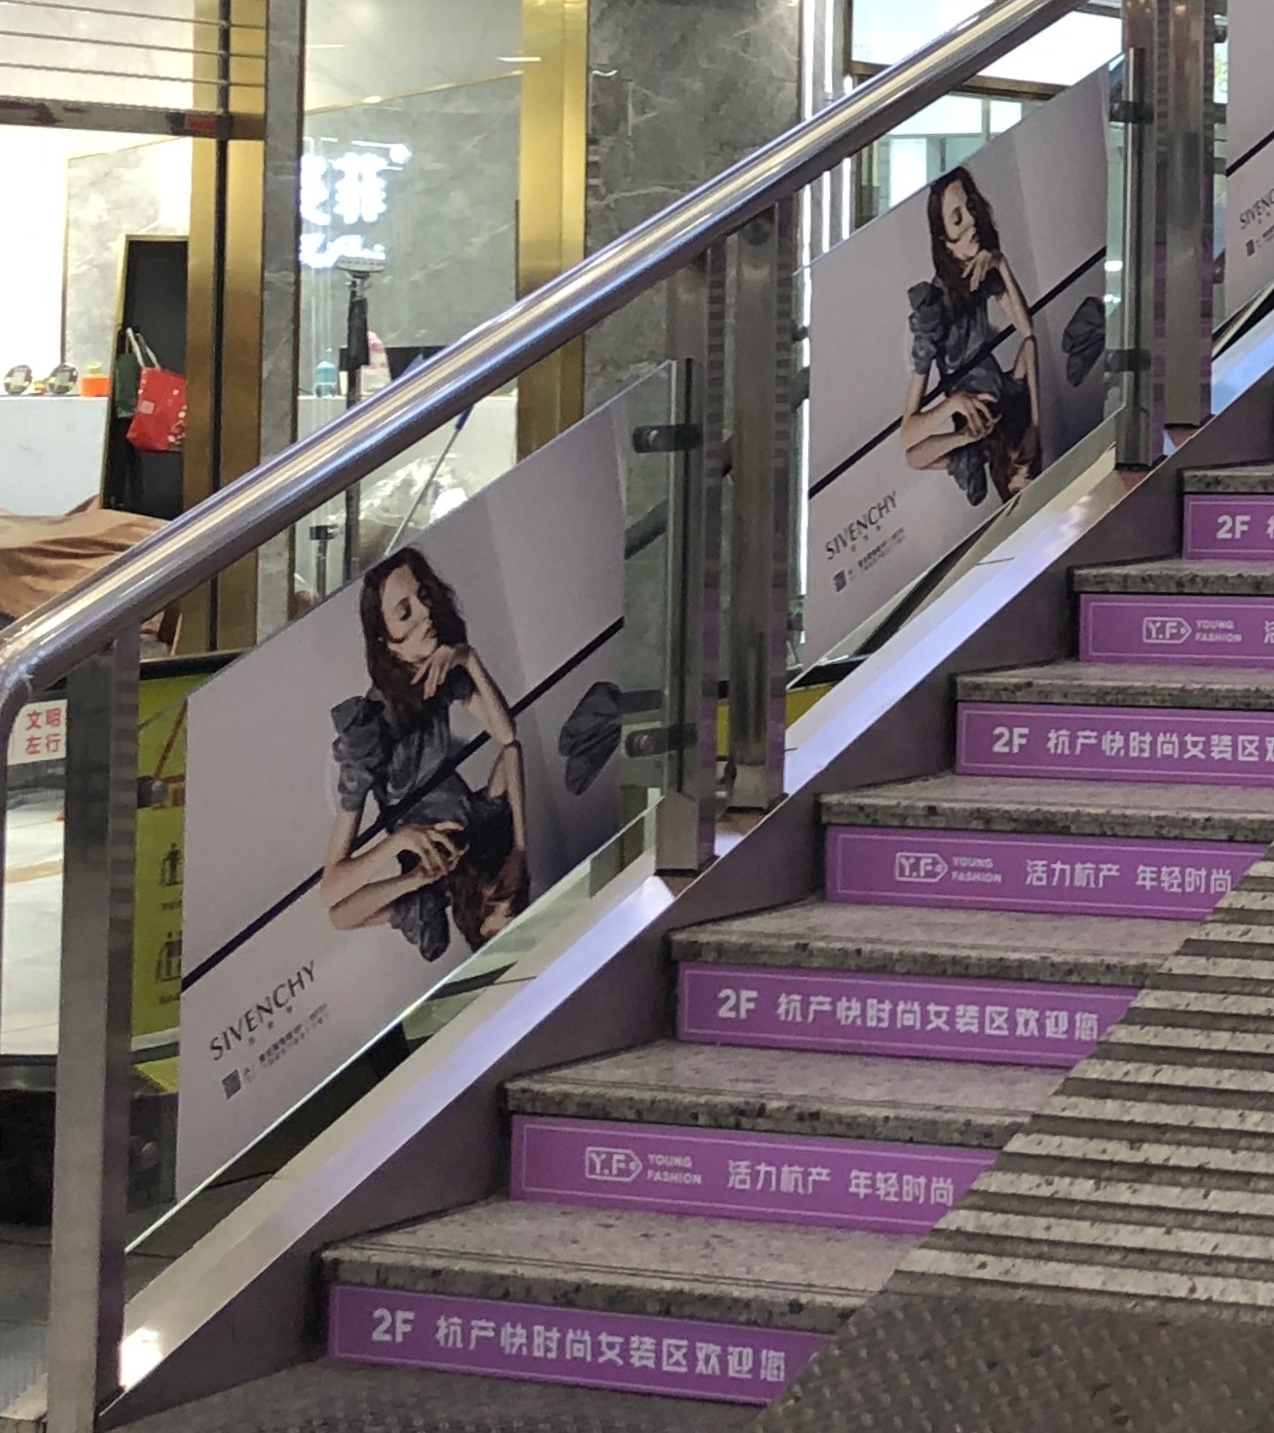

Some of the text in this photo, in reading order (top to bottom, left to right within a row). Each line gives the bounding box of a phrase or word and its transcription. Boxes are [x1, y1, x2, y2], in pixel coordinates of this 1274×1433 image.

[825, 490, 898, 560] SIVENCHY
[1217, 515, 1251, 540] 2F
[26, 707, 62, 730] 文明
[25, 732, 62, 756] 左行
[992, 727, 1029, 753] 2F
[1025, 860, 1232, 893] 活力杭产 年轻时尚
[210, 960, 317, 1061] SIVENCHY
[717, 990, 1098, 1041] 2F 杭产快时尚女装区欢迎您
[728, 1161, 954, 1206] 活力杭产 年轻时尚
[372, 1309, 786, 1382] 2F 杭产快时尚女装区欢迎您
